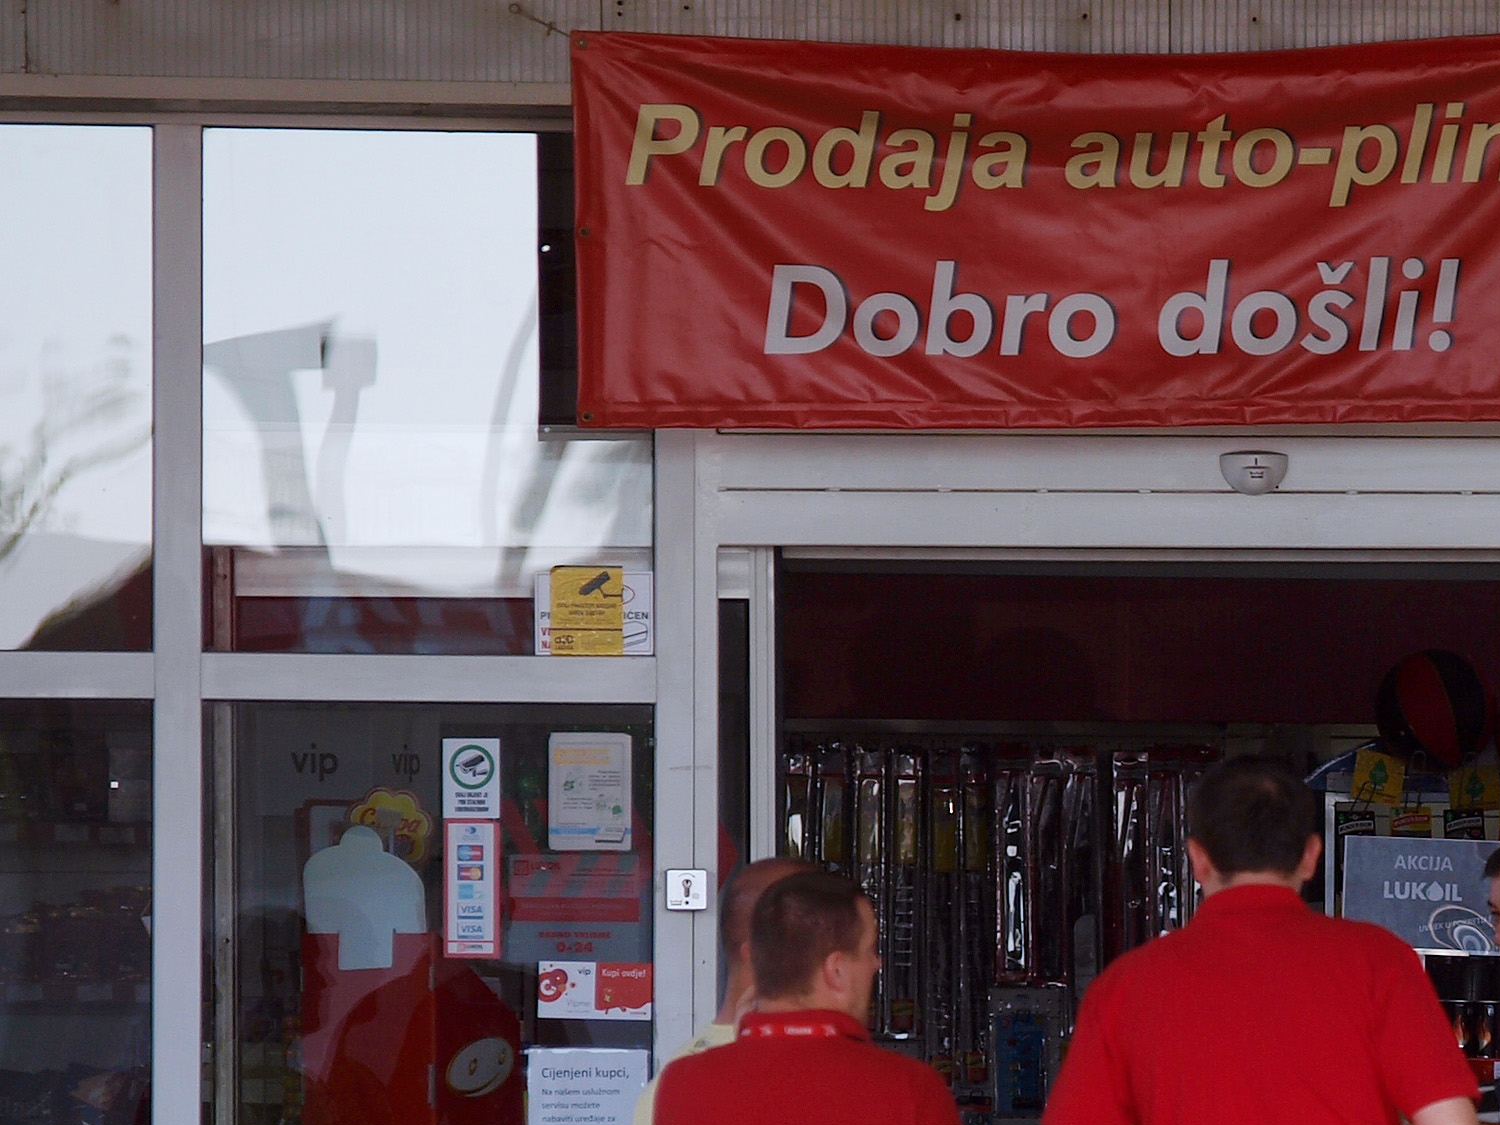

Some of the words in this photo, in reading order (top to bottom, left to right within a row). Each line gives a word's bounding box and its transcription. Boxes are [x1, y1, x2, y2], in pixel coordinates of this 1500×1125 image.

[625, 102, 1027, 212] Prodaja
[762, 259, 1117, 360] Dobro
[1156, 257, 1461, 357] došli!
[290, 743, 339, 783] vip
[391, 744, 421, 783] vip
[1394, 854, 1453, 872] AKCIJA
[461, 905, 482, 914] VISA
[461, 925, 483, 933] VISA
[578, 967, 591, 976] vip
[601, 968, 620, 978] Kupi
[621, 968, 647, 980] ovdje!
[541, 1067, 592, 1081] Cijenjeni
[595, 1067, 630, 1080] kupci,
[541, 1088, 553, 1096] Na
